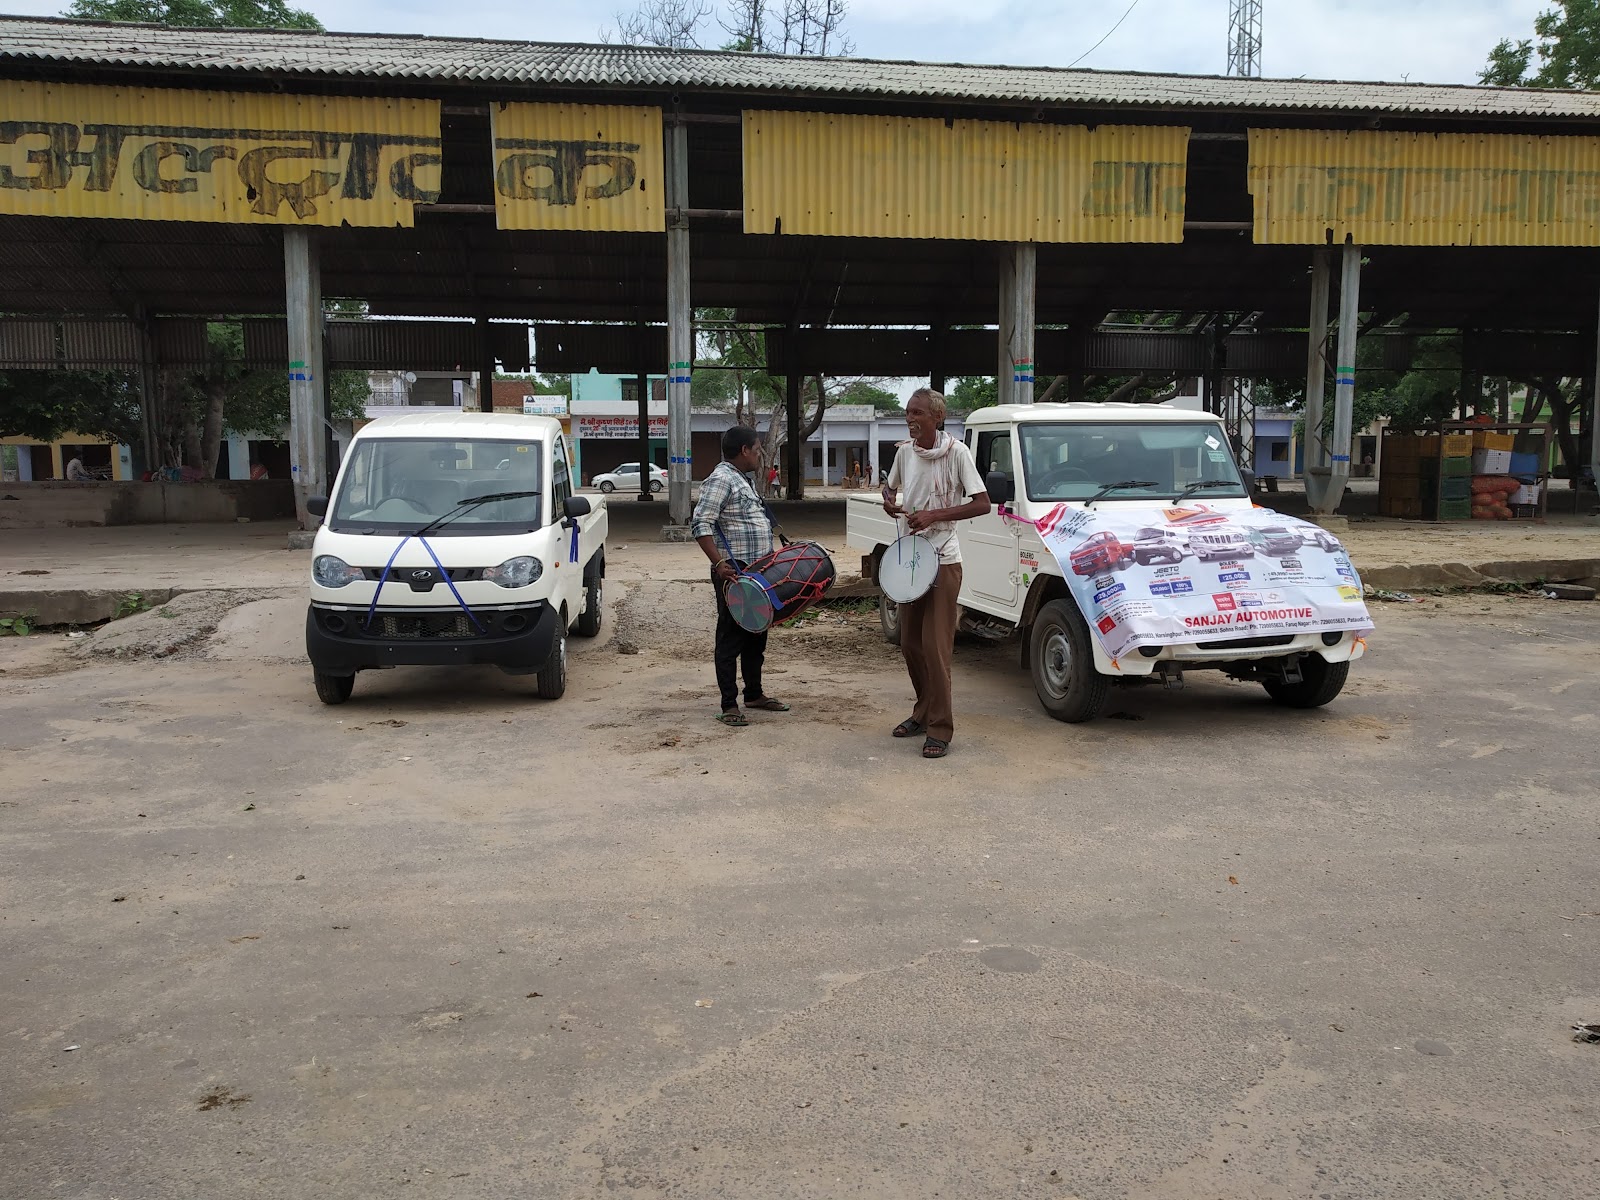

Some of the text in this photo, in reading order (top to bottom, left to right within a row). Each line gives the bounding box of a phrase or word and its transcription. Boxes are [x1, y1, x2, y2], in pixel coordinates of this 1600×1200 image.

[1020, 551, 1035, 560] BOLERO
[1153, 565, 1180, 575] JEETO
[1184, 607, 1313, 627] SANJAY AUTOMOTIVE
